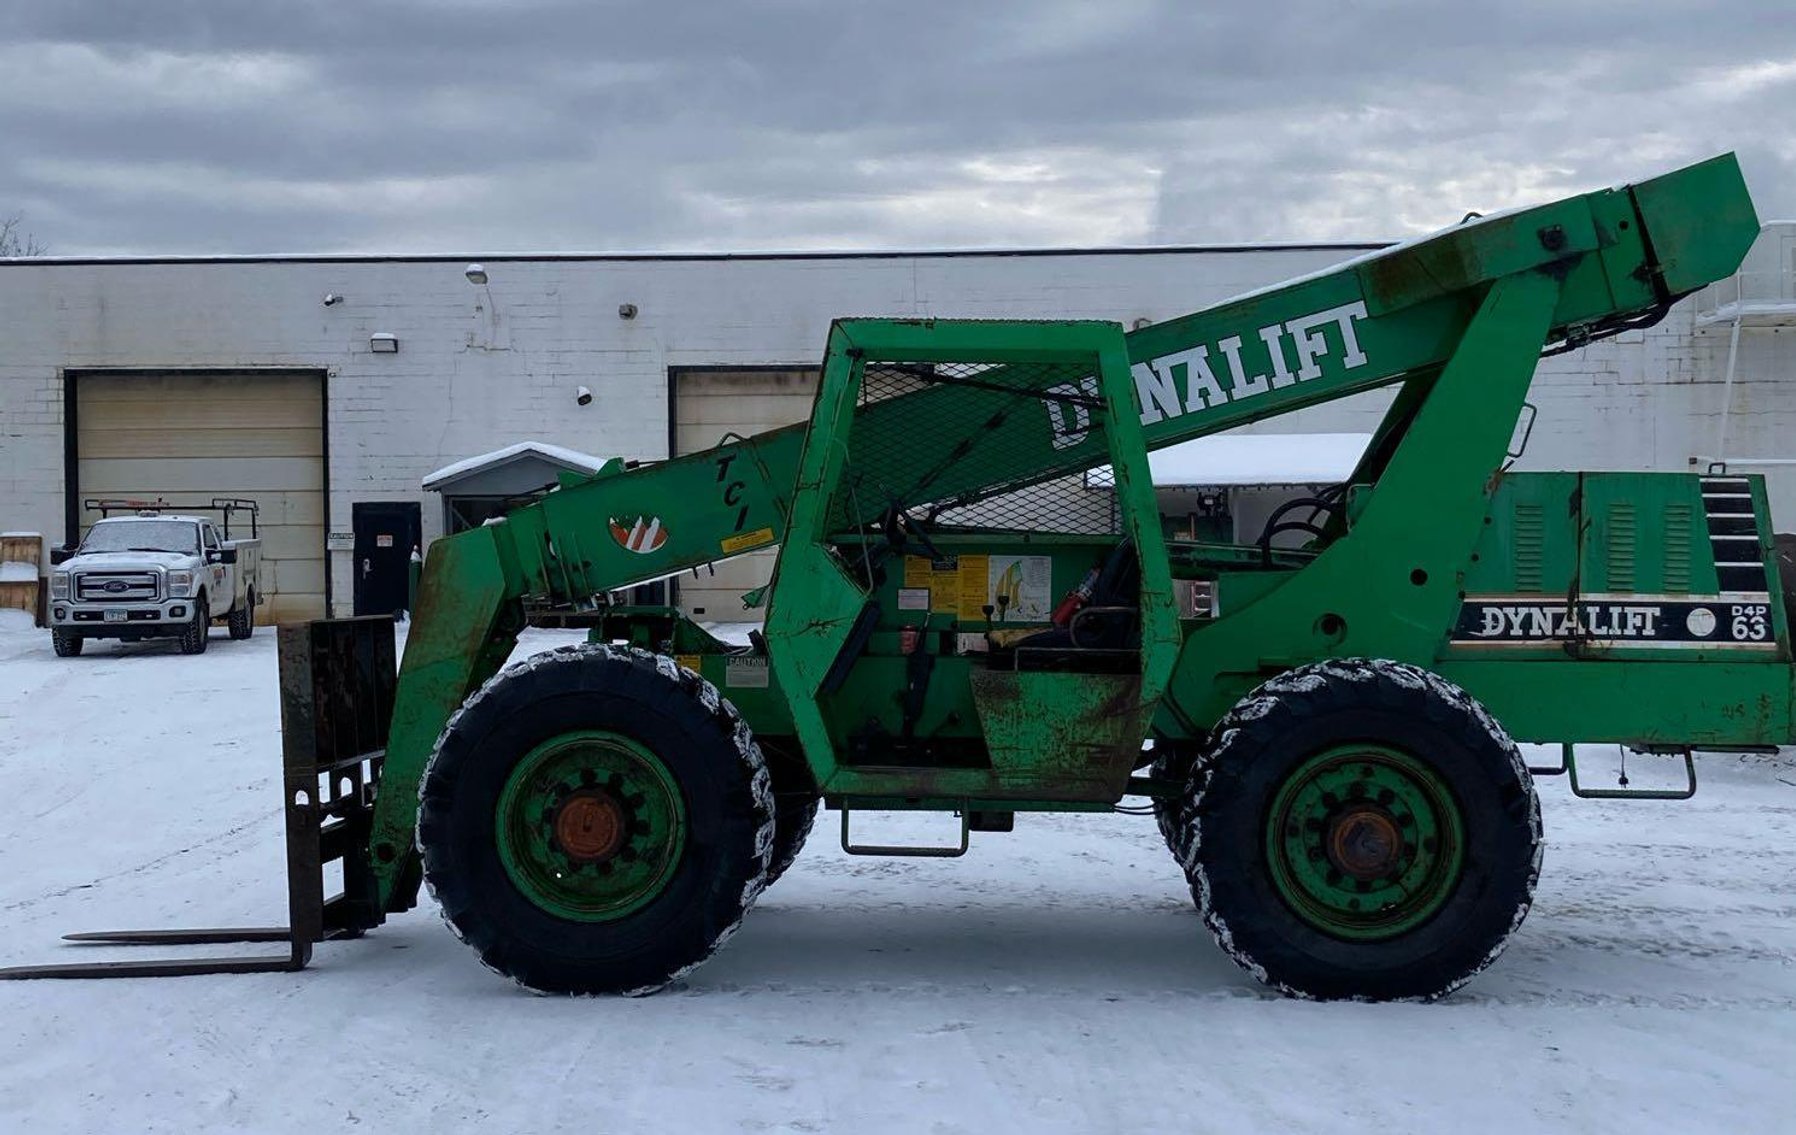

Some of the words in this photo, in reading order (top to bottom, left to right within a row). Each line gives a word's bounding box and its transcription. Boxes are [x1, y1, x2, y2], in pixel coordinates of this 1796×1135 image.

[1041, 300, 1368, 451] DNALIFT
[1479, 606, 1661, 637] DYNALIFT
[1732, 616, 1766, 640] 63
[728, 657, 767, 667] CAUTION
